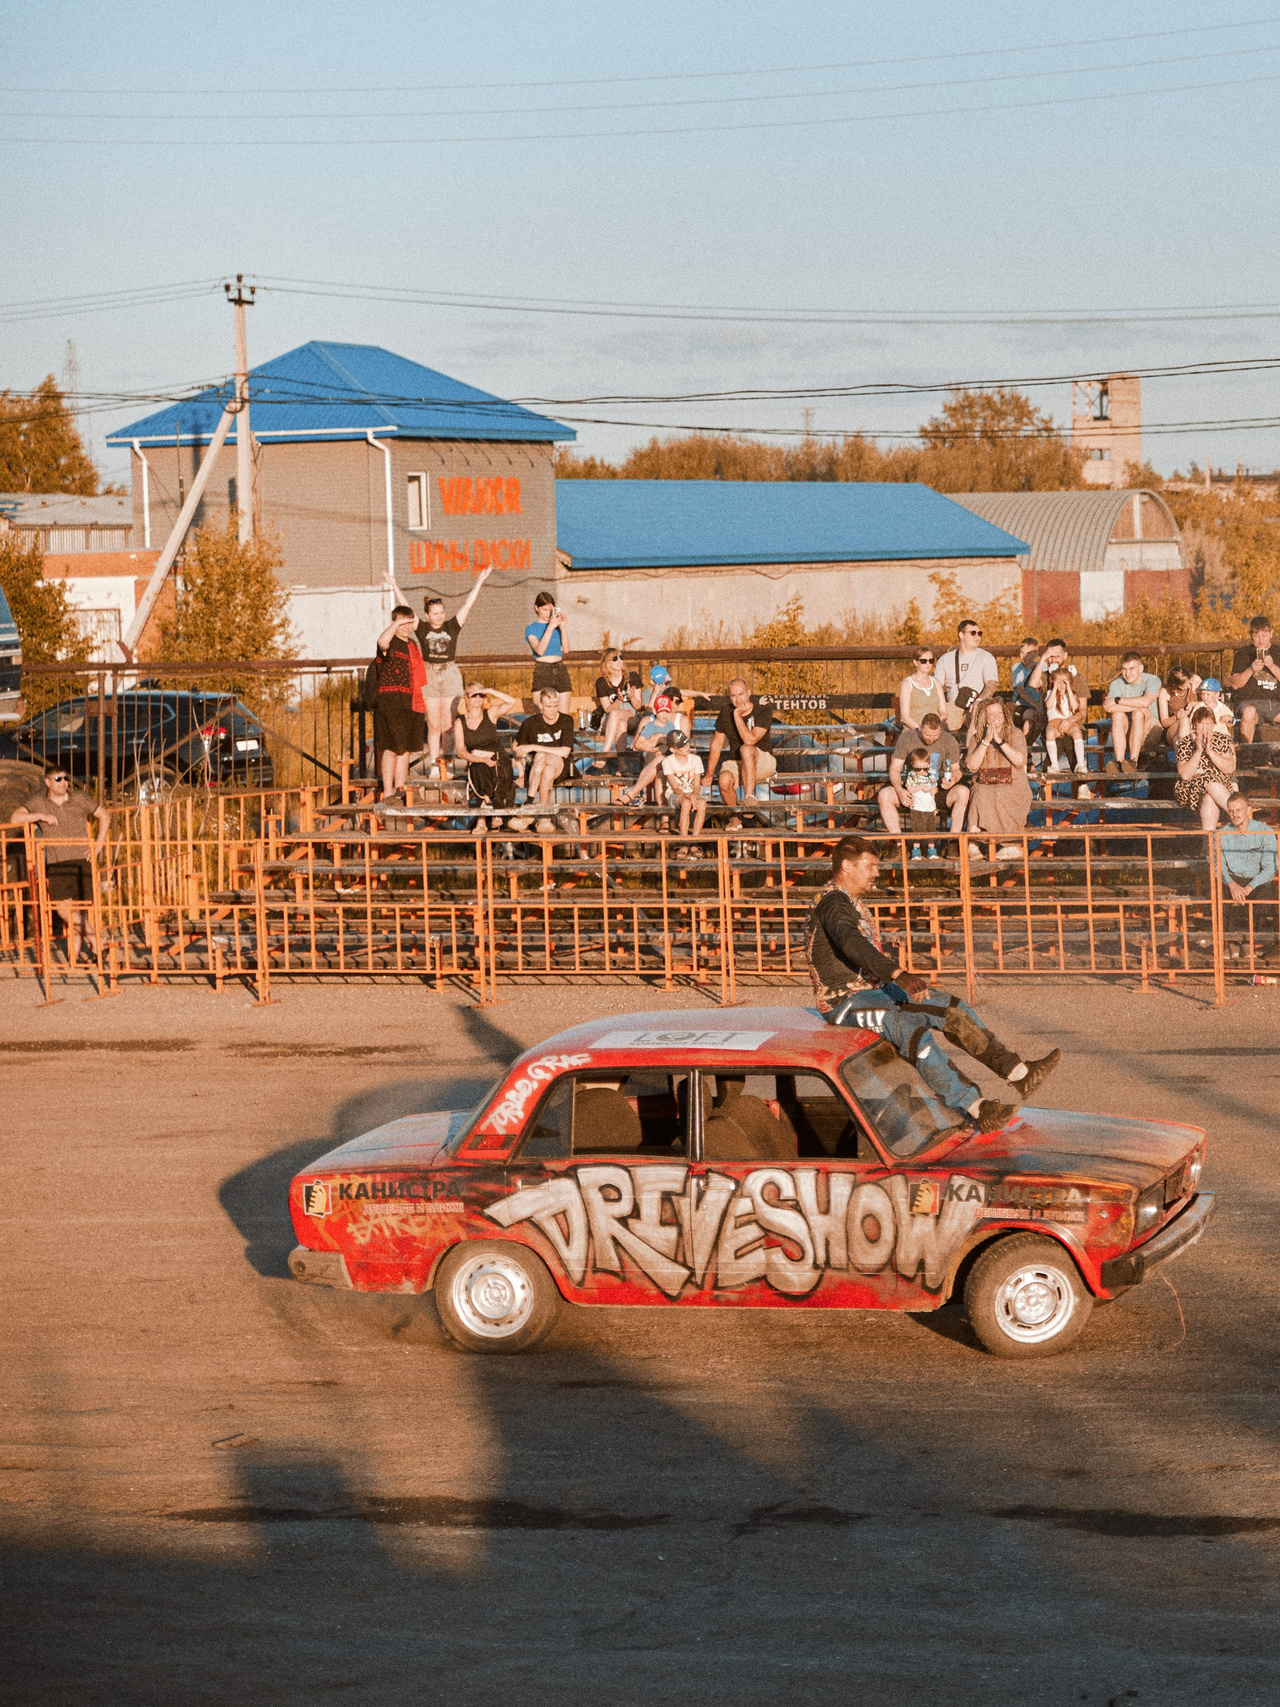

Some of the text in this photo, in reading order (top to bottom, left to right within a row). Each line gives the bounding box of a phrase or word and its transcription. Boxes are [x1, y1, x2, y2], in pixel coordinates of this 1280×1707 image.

[437, 475, 523, 516] VIANOR
[409, 538, 532, 577] ШИНЫ ДИСКИ
[774, 699, 827, 710] ТЕНТОВ
[856, 1009, 886, 1028] FLY
[633, 1031, 747, 1043] LOFT
[338, 1180, 462, 1201] КАНИСТРА
[948, 1182, 1084, 1207] КАНИСТРА
[426, 1202, 464, 1213] БЛИЖЕ
